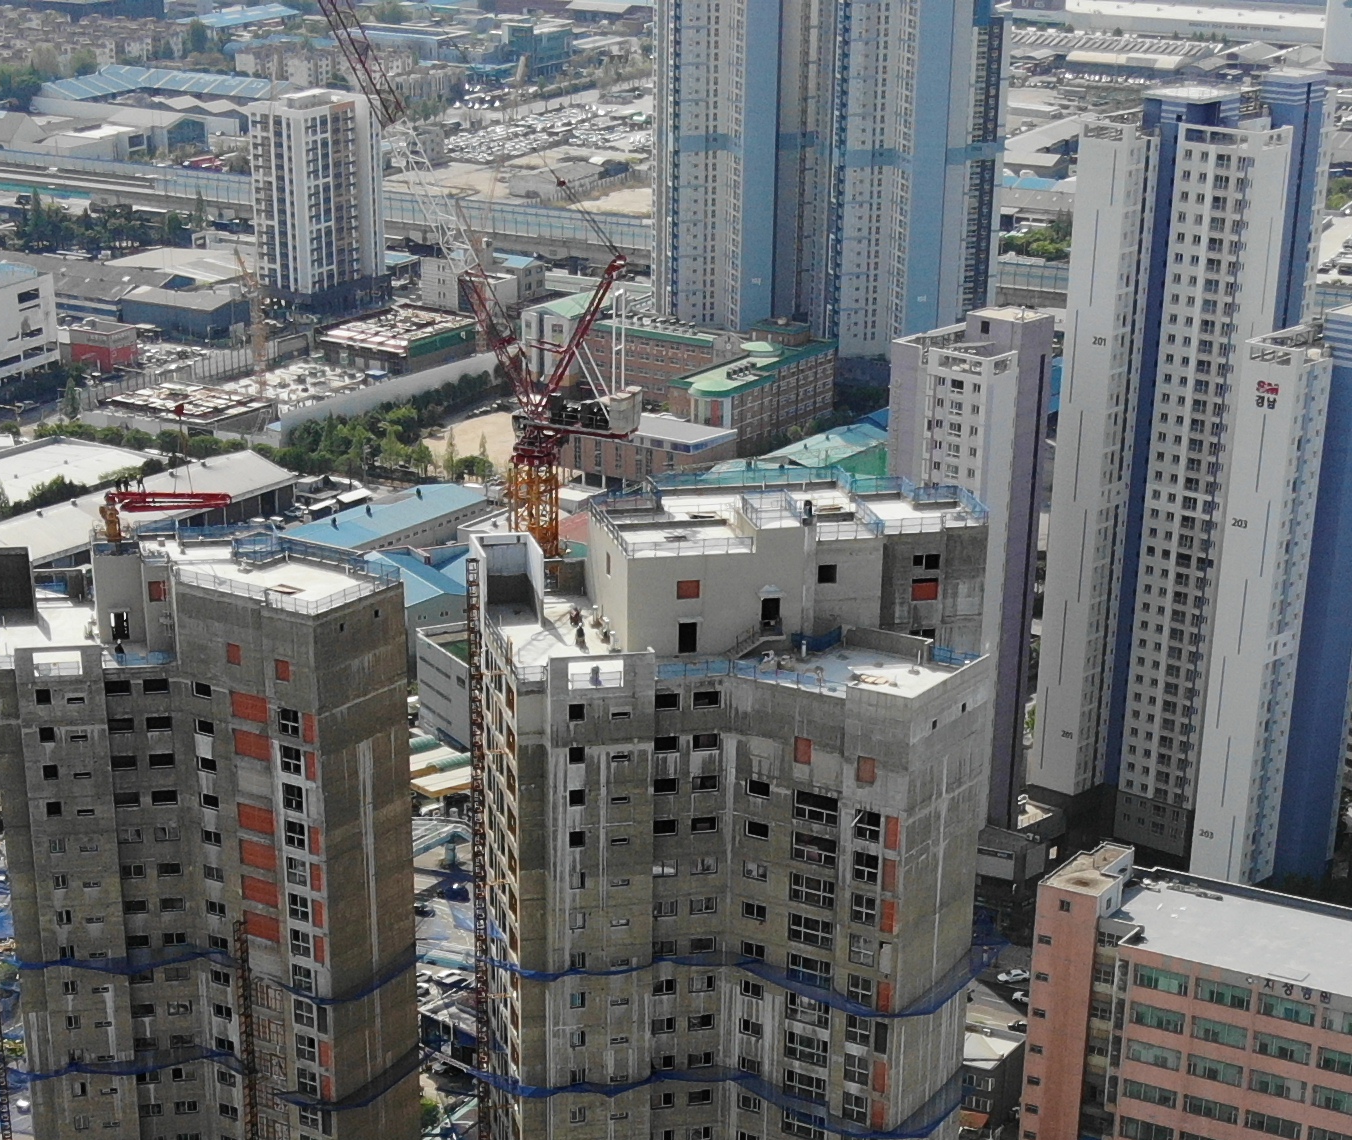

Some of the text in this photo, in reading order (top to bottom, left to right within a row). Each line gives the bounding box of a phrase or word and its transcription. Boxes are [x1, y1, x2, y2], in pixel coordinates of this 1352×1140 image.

[1092, 336, 1107, 347] 201
[1256, 395, 1277, 410] 경남
[1231, 517, 1248, 529] 203
